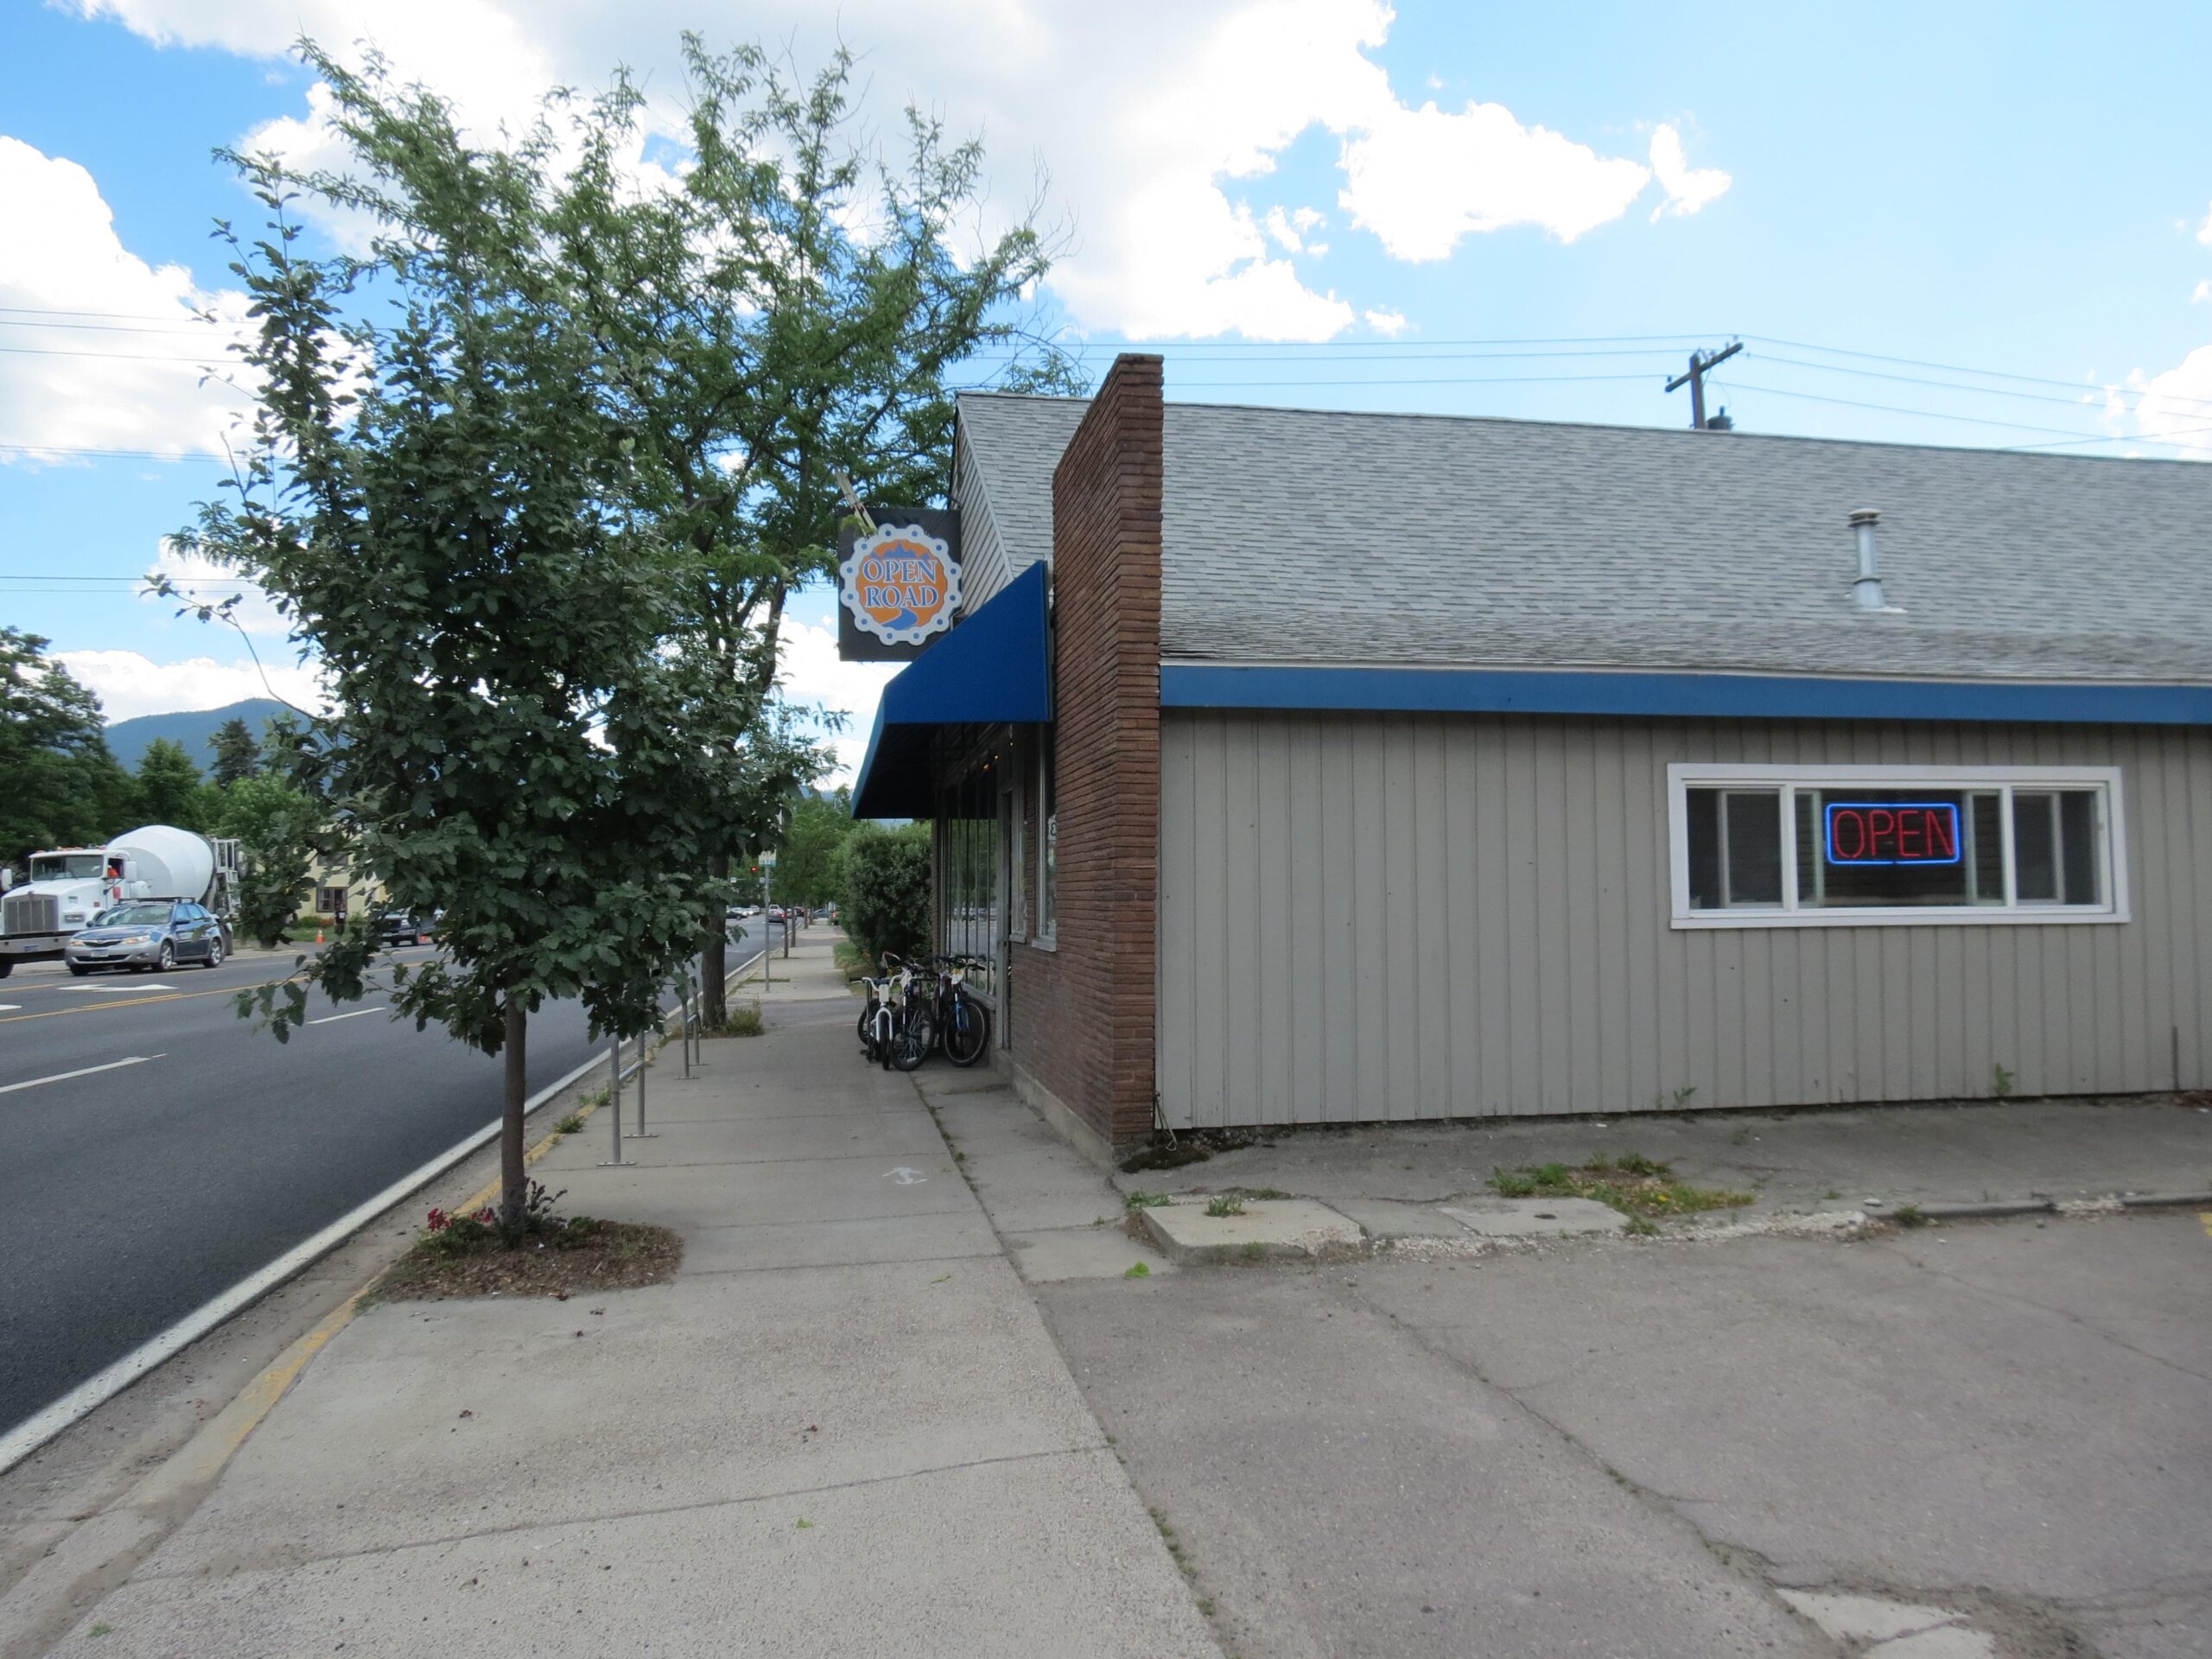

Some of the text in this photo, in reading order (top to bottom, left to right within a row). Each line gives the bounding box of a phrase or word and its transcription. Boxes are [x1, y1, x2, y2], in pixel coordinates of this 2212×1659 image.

[863, 559, 937, 583] OPEN
[865, 586, 939, 608] ROAD
[1833, 809, 1955, 858] OPEN
